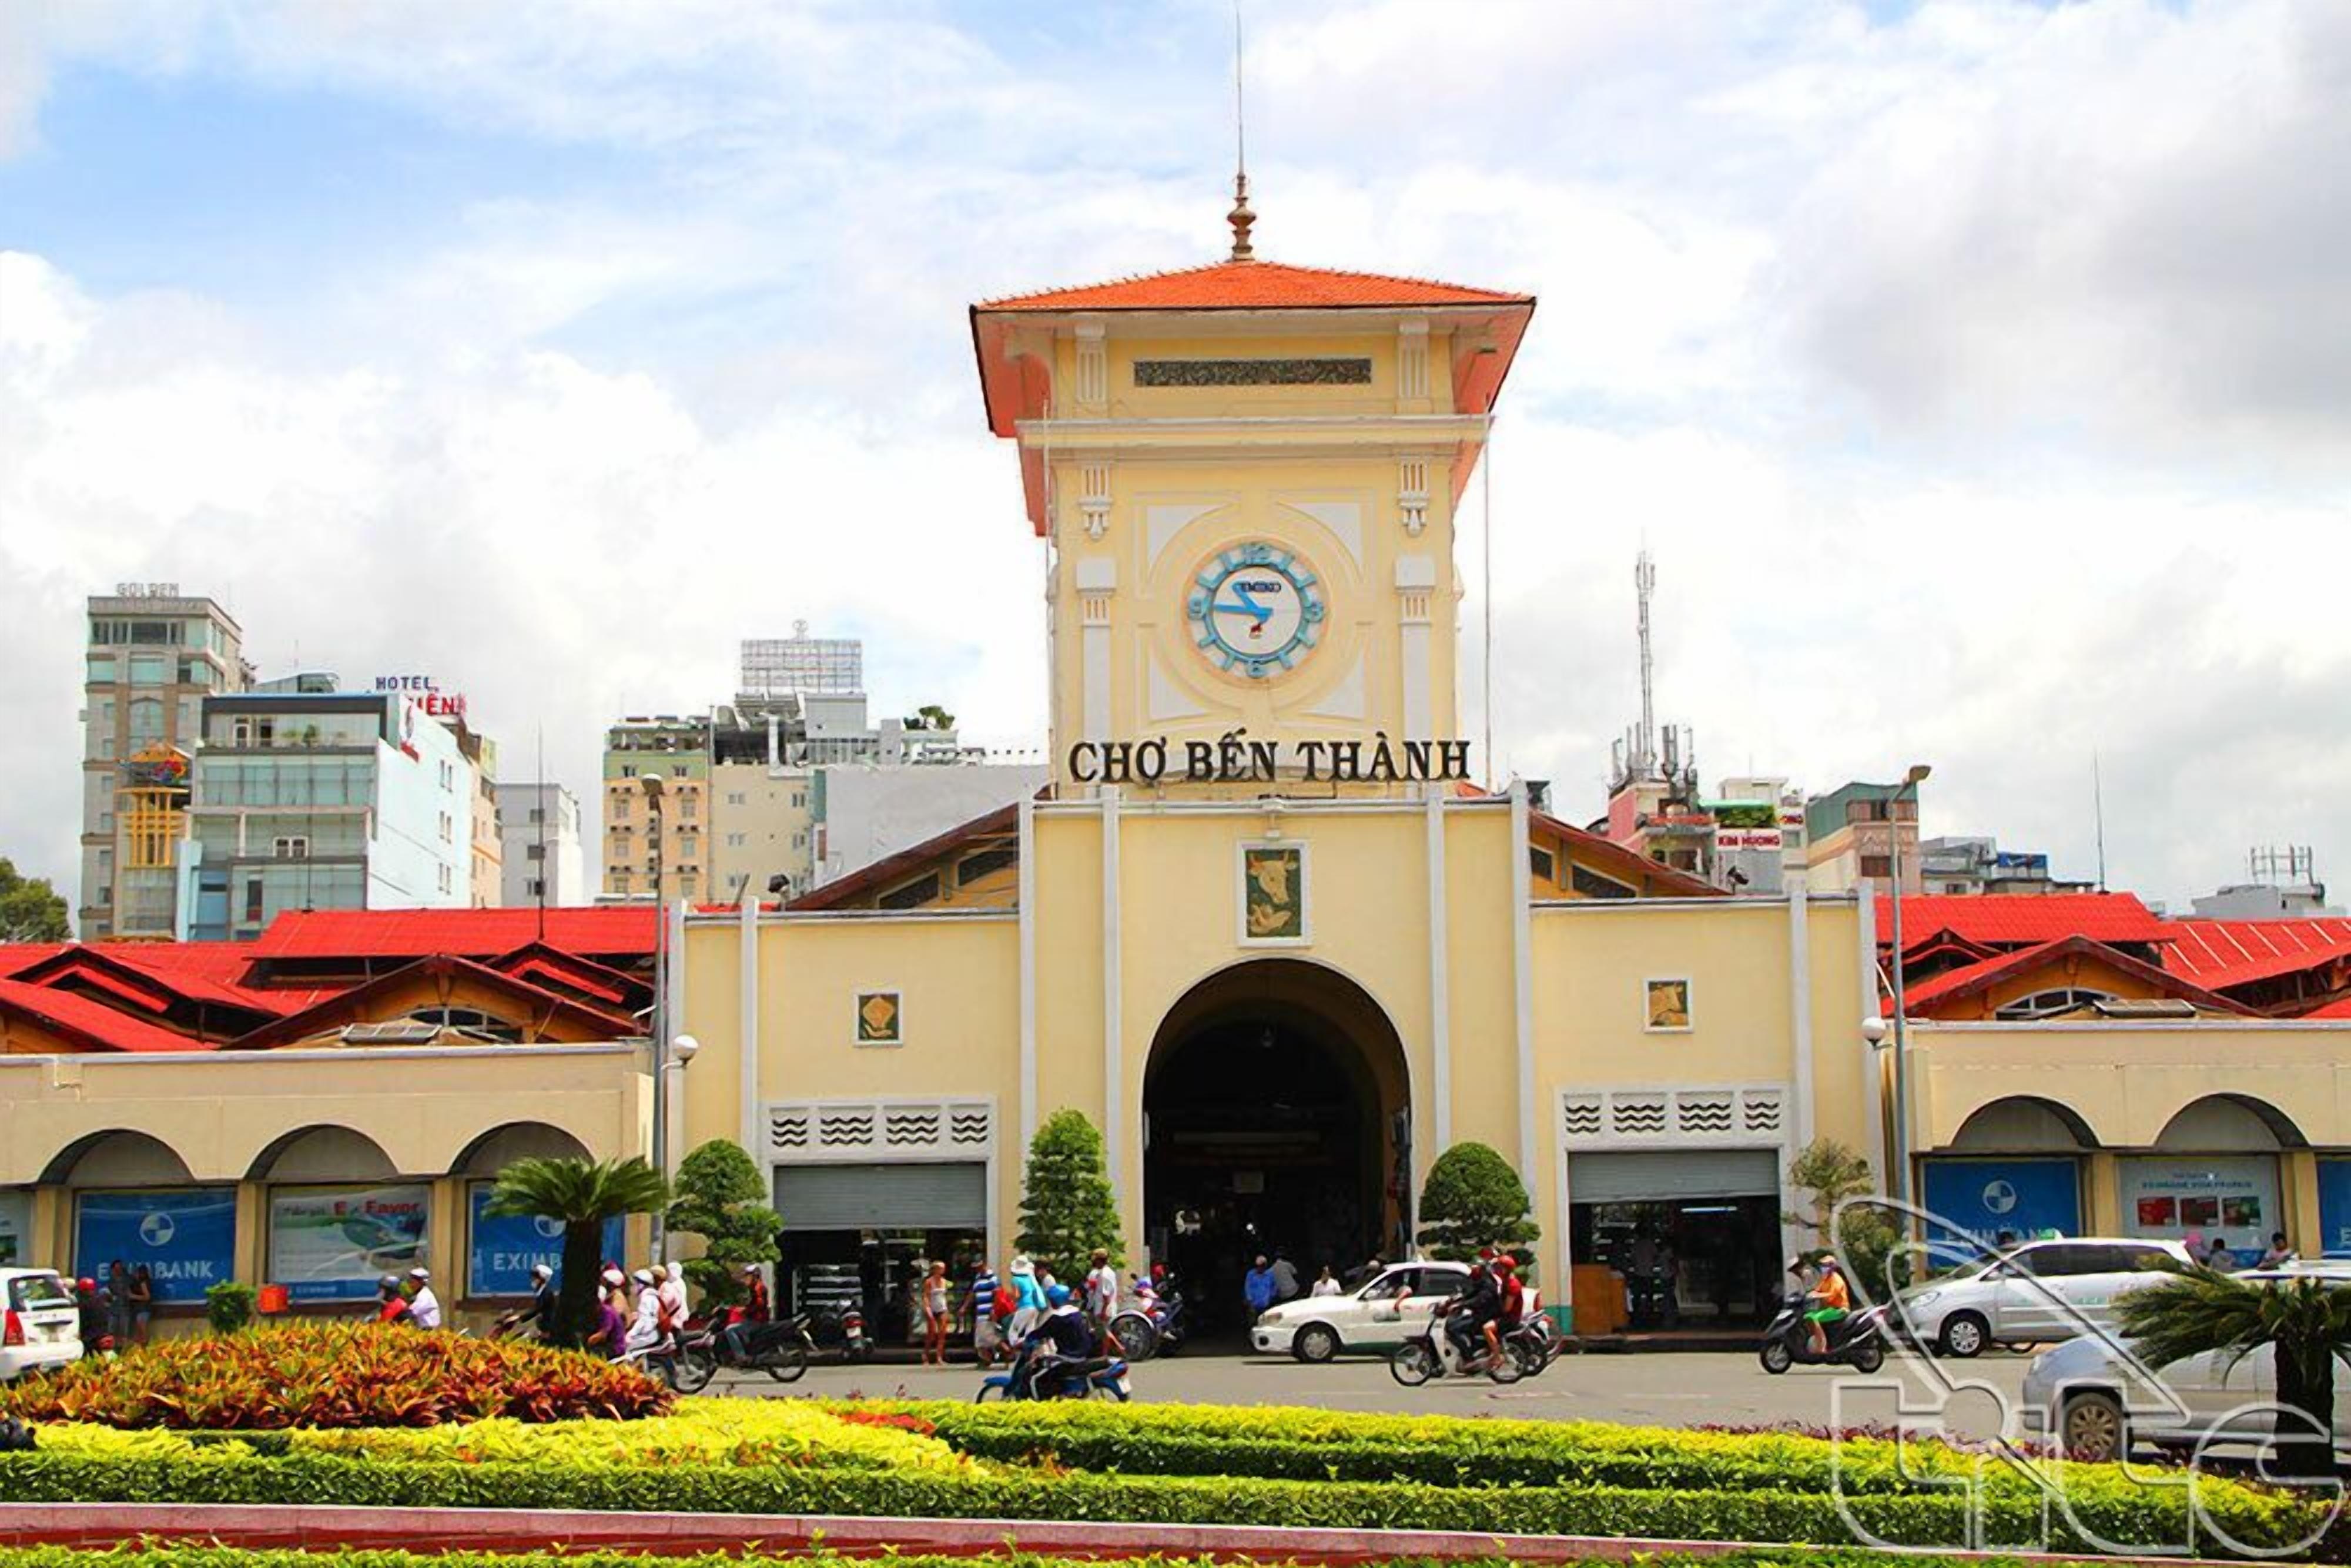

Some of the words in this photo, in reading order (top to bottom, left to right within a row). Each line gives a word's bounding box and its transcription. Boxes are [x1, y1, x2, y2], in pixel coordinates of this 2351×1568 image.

[376, 676, 432, 690] HOTEL
[1069, 736, 1167, 786] CHỢ
[1185, 728, 1278, 782] BẾN
[1295, 731, 1471, 782] THÀNH
